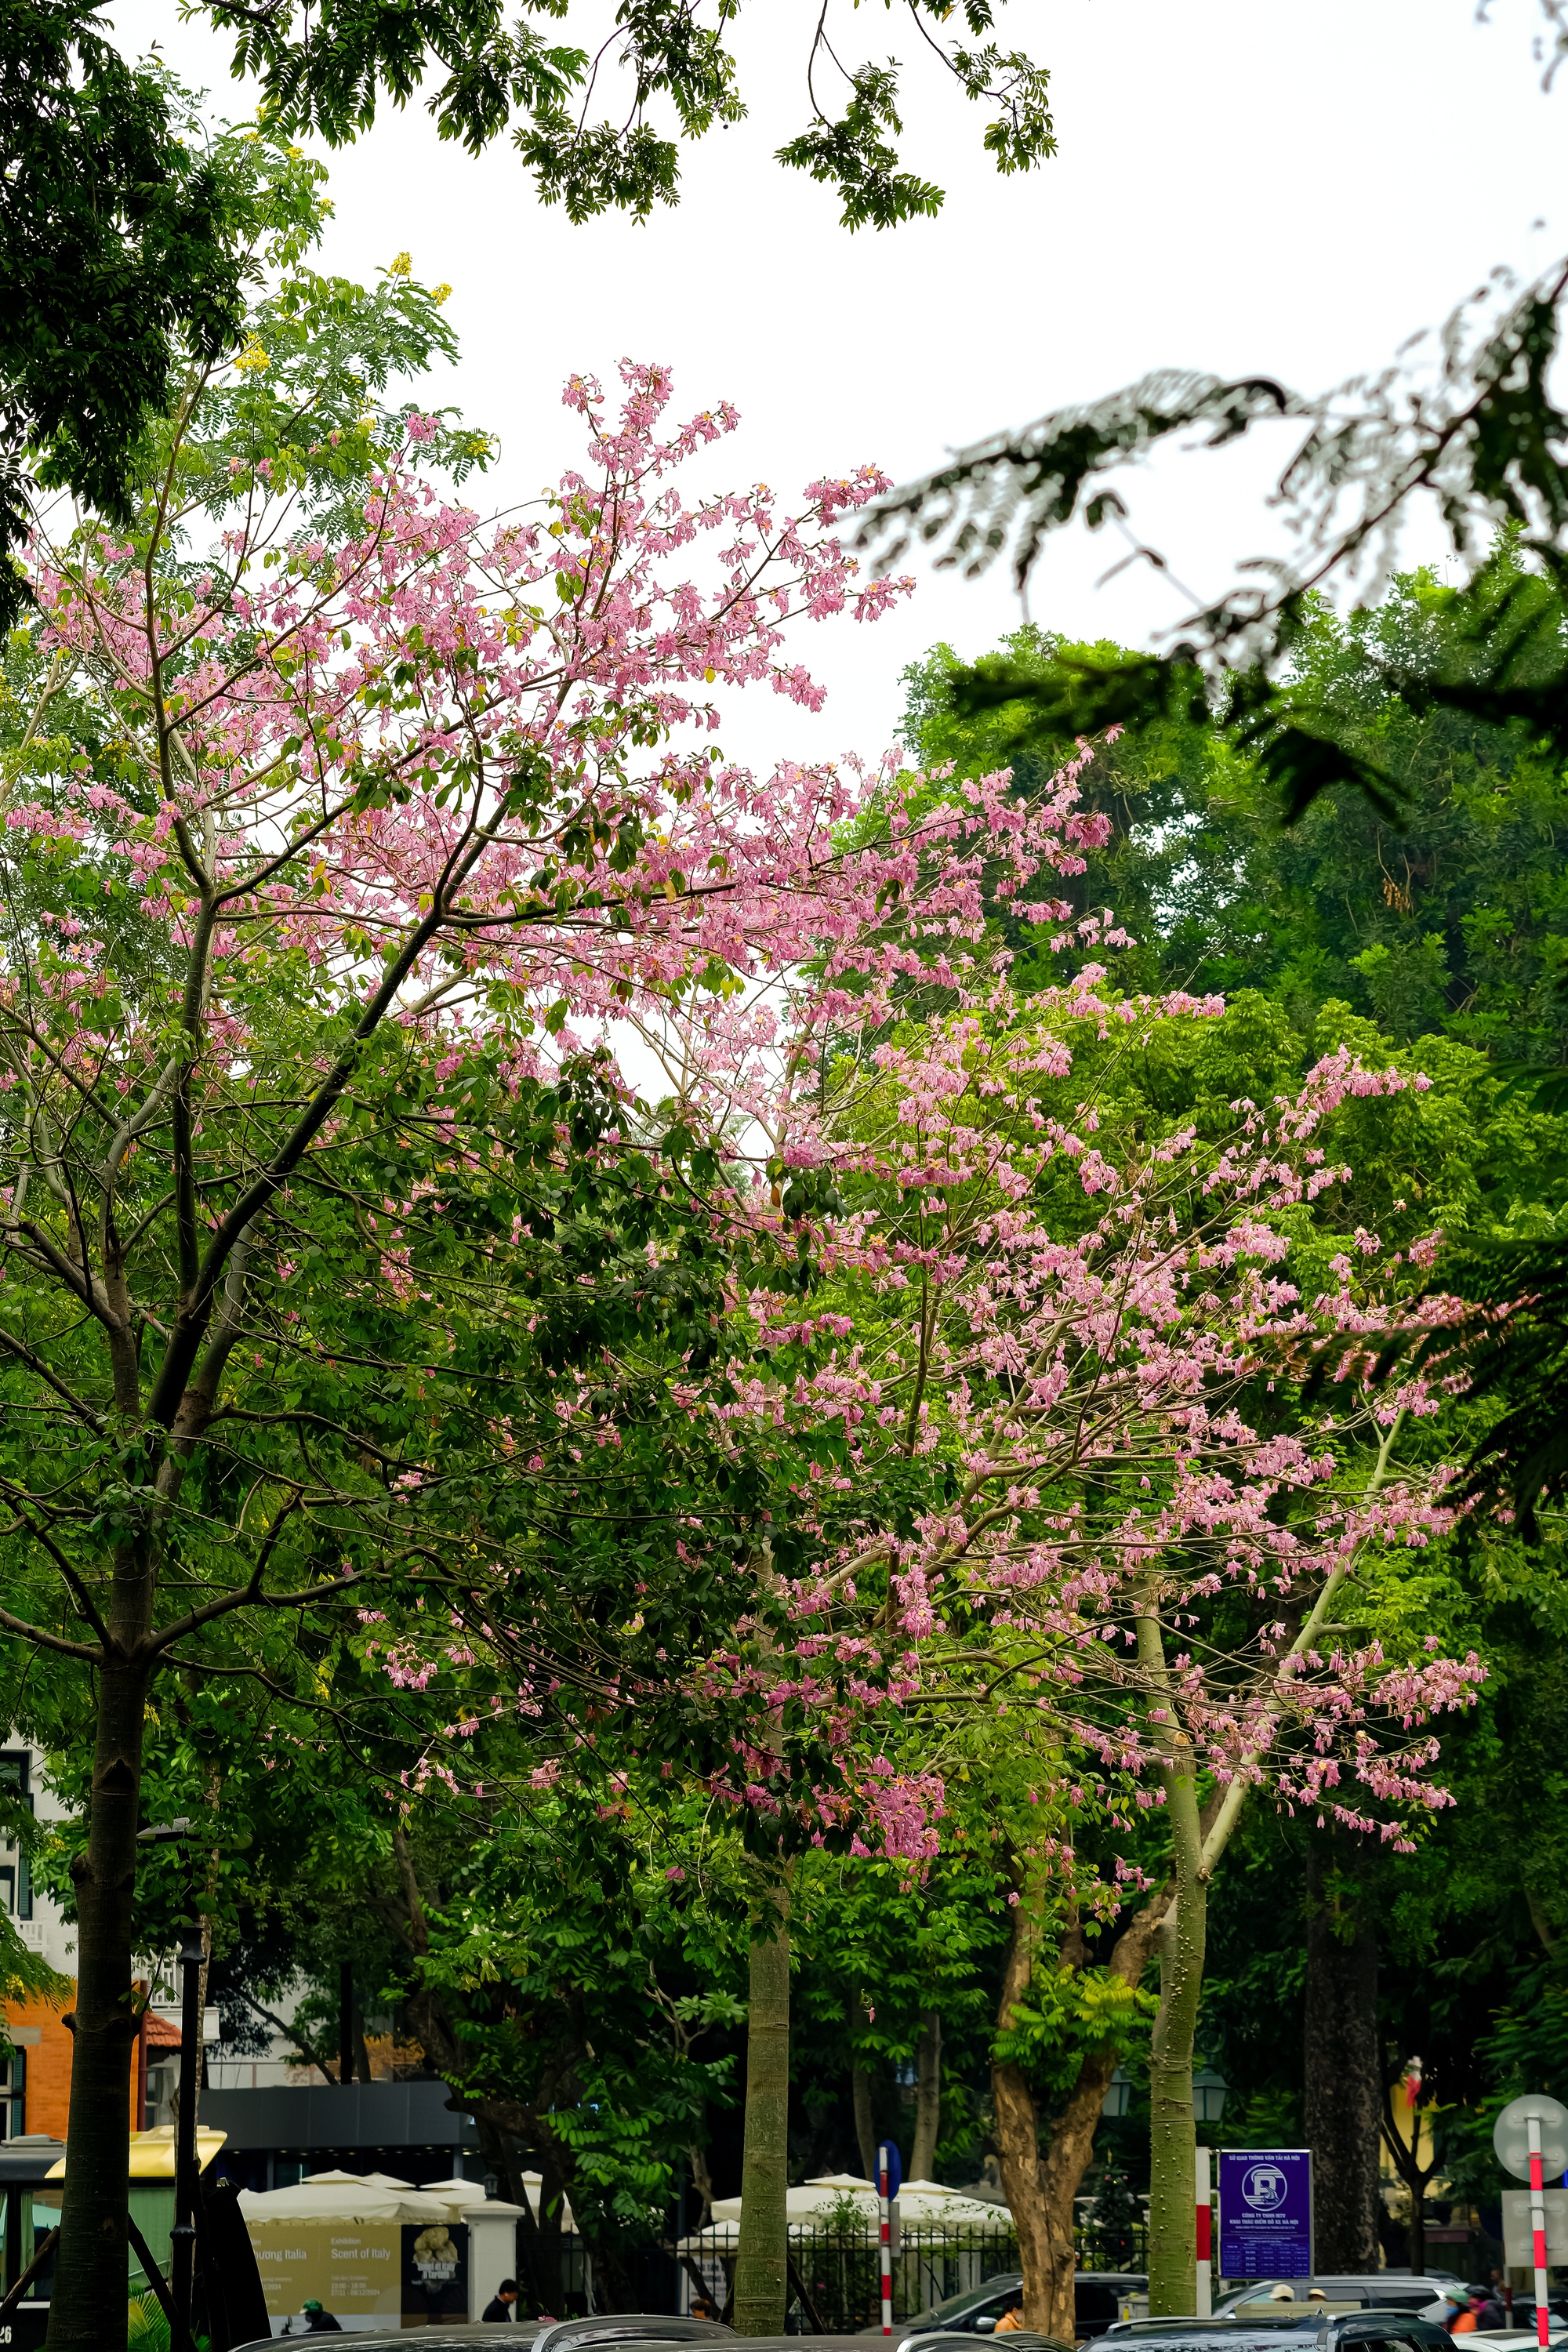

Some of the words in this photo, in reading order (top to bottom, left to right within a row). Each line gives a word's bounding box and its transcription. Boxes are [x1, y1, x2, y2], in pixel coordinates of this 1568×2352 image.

[285, 2248, 307, 2259] Italia
[332, 2249, 358, 2259] Scent
[361, 2248, 369, 2259] of
[372, 2248, 390, 2261] Italy
